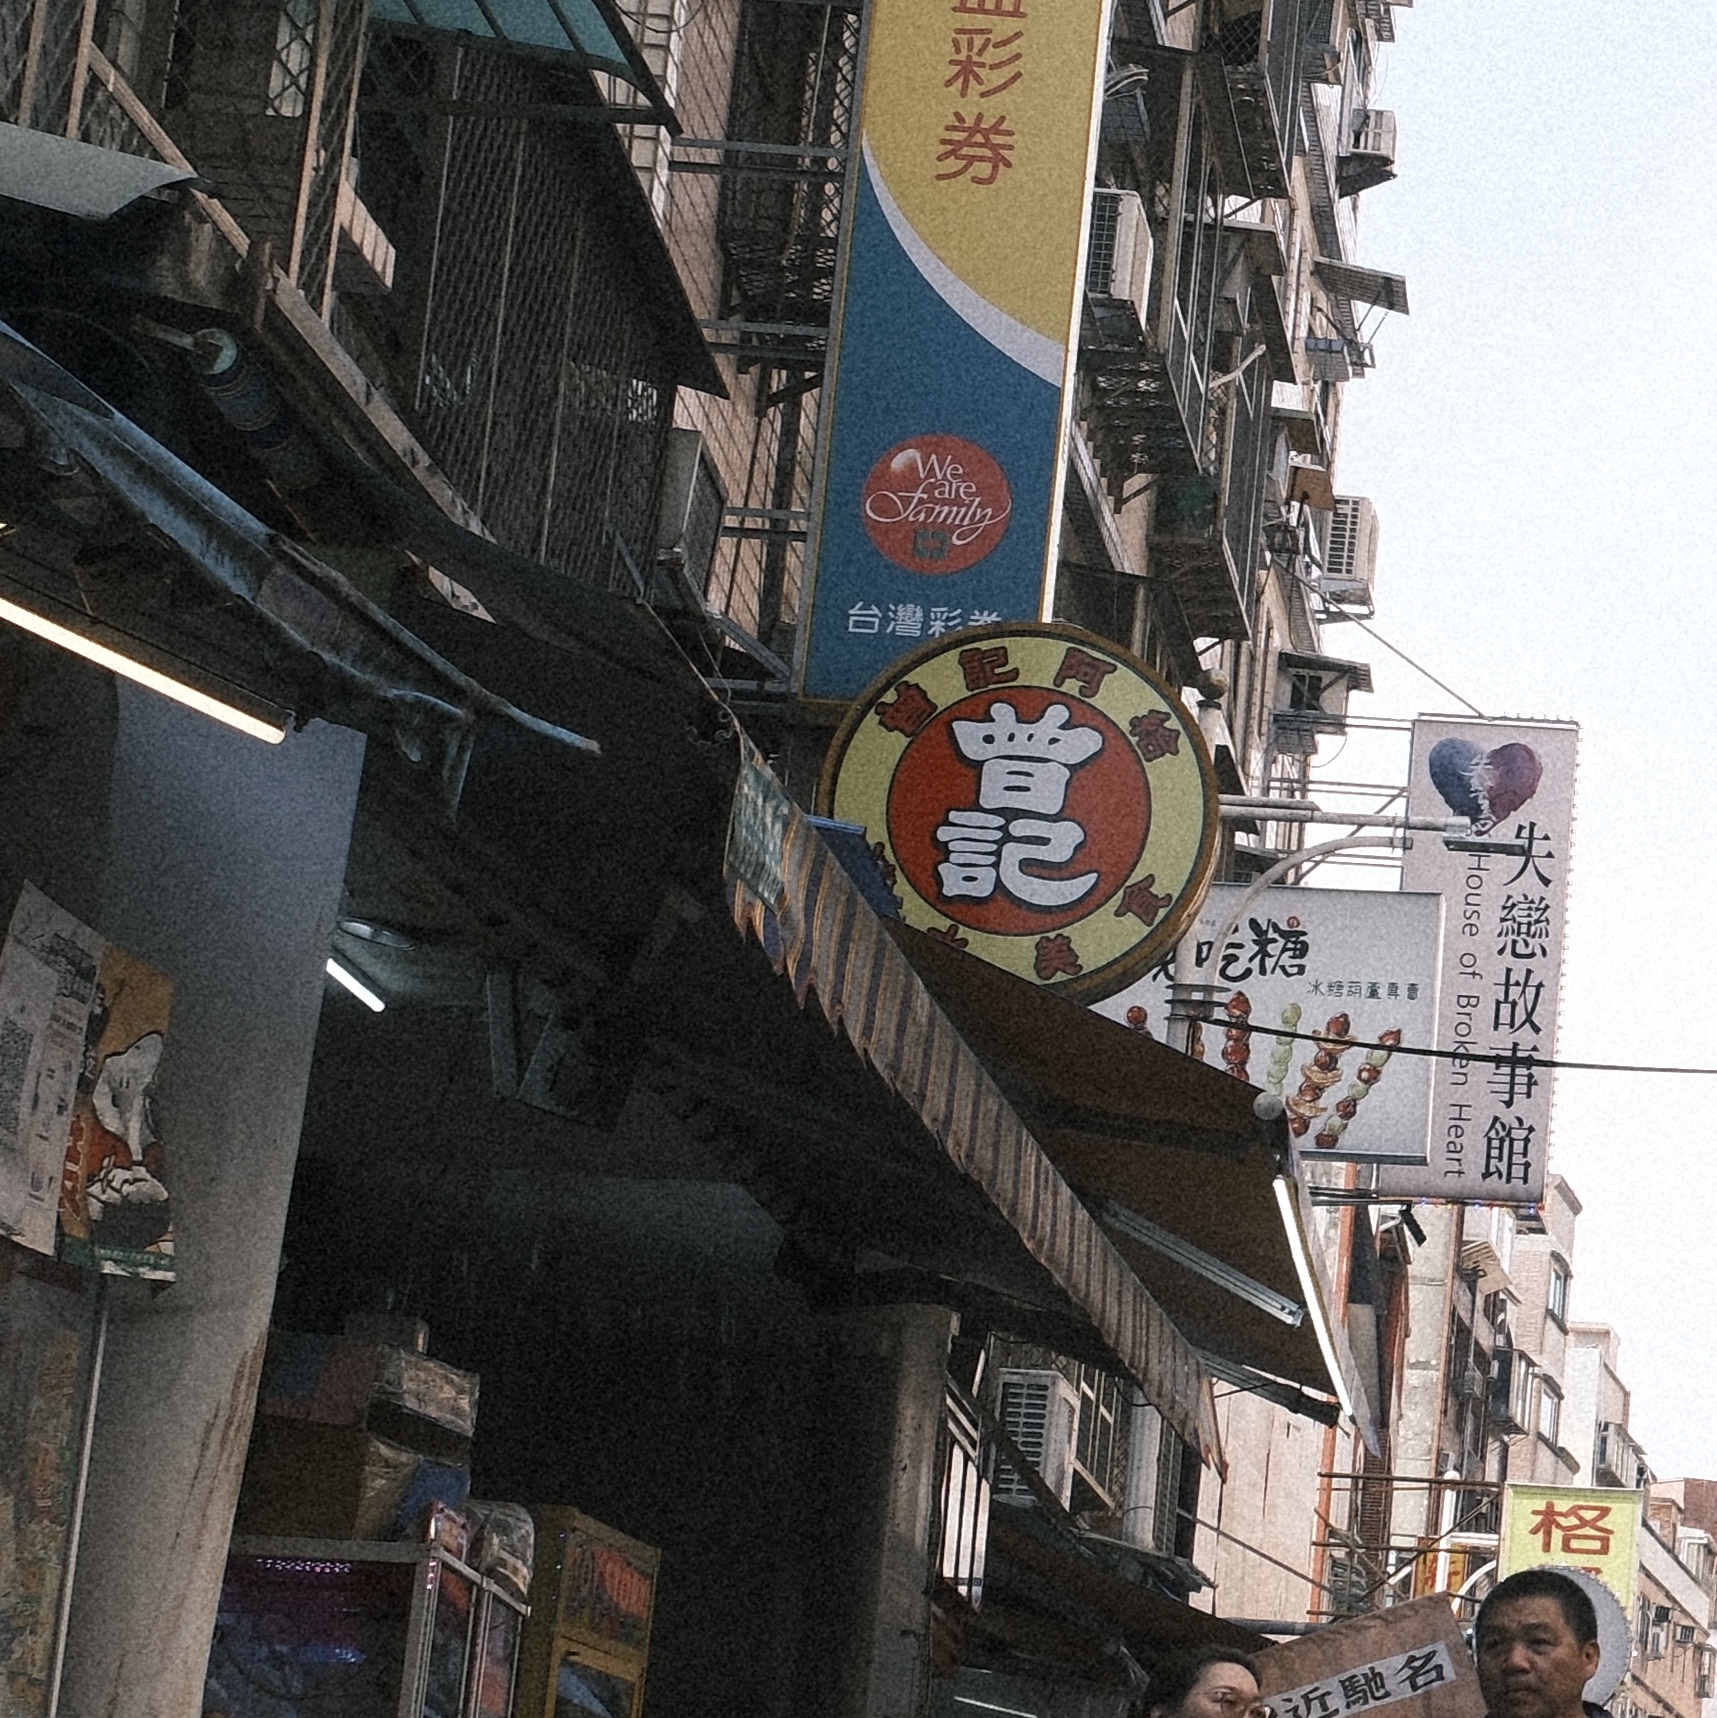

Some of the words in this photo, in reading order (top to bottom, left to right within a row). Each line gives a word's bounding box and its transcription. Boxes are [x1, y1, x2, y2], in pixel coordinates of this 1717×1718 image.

[891, 449, 963, 481] We
[935, 479, 976, 500] are
[866, 477, 1012, 545] Family
[1460, 854, 1491, 938] House
[1458, 954, 1483, 981] of
[1480, 821, 1556, 1186] 失戀故事館
[1450, 994, 1482, 1086] Broken
[1443, 1104, 1475, 1178] Heart
[1529, 1500, 1615, 1576] 格
